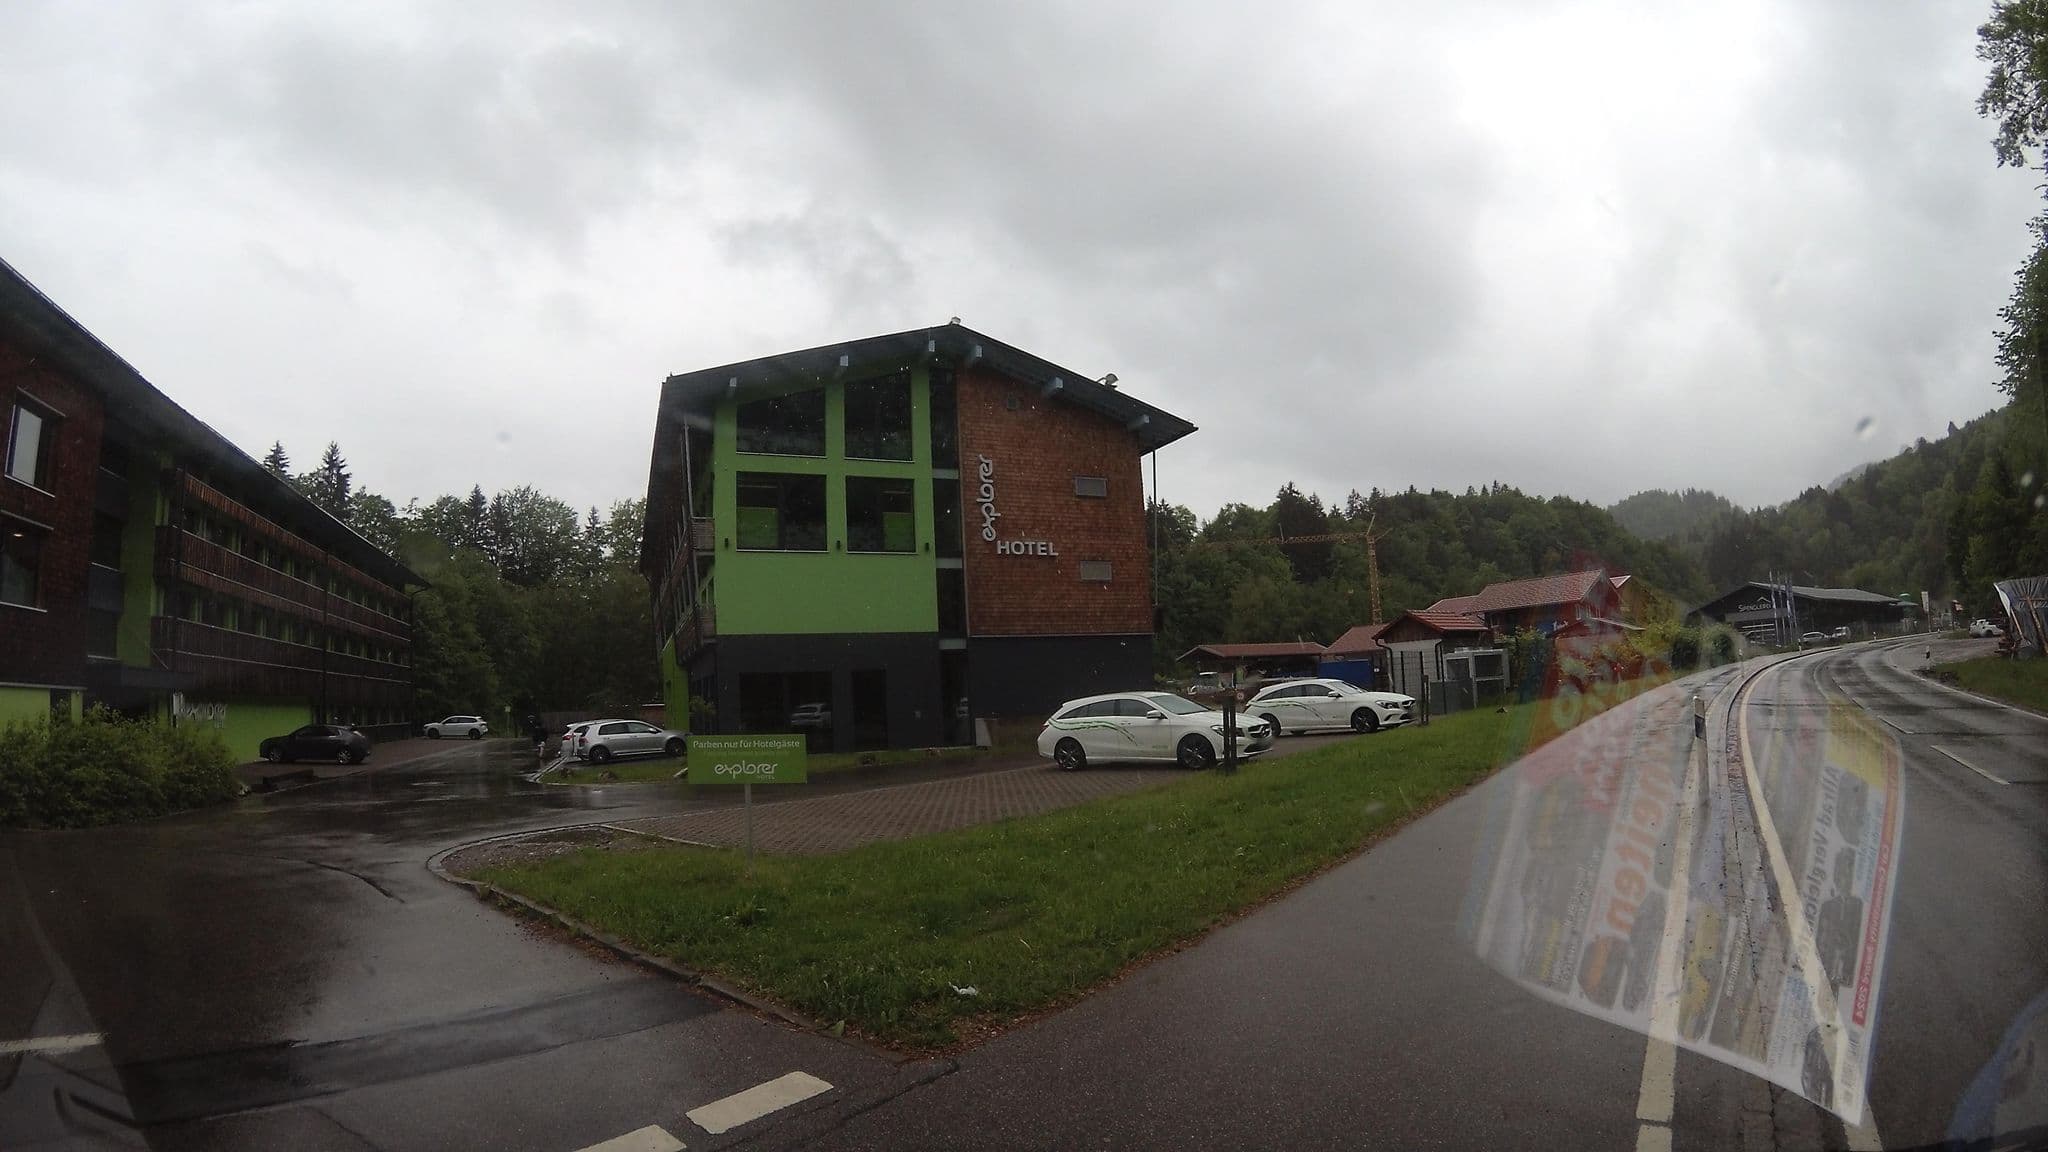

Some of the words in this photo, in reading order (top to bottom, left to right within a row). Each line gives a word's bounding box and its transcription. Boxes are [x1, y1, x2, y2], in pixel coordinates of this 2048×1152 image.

[976, 453, 1001, 542] explorer
[996, 540, 1059, 556] HOTEL
[693, 740, 722, 749] Parken
[739, 739, 752, 748] für
[753, 739, 800, 750] Hotelgäste
[714, 759, 778, 780] explorer
